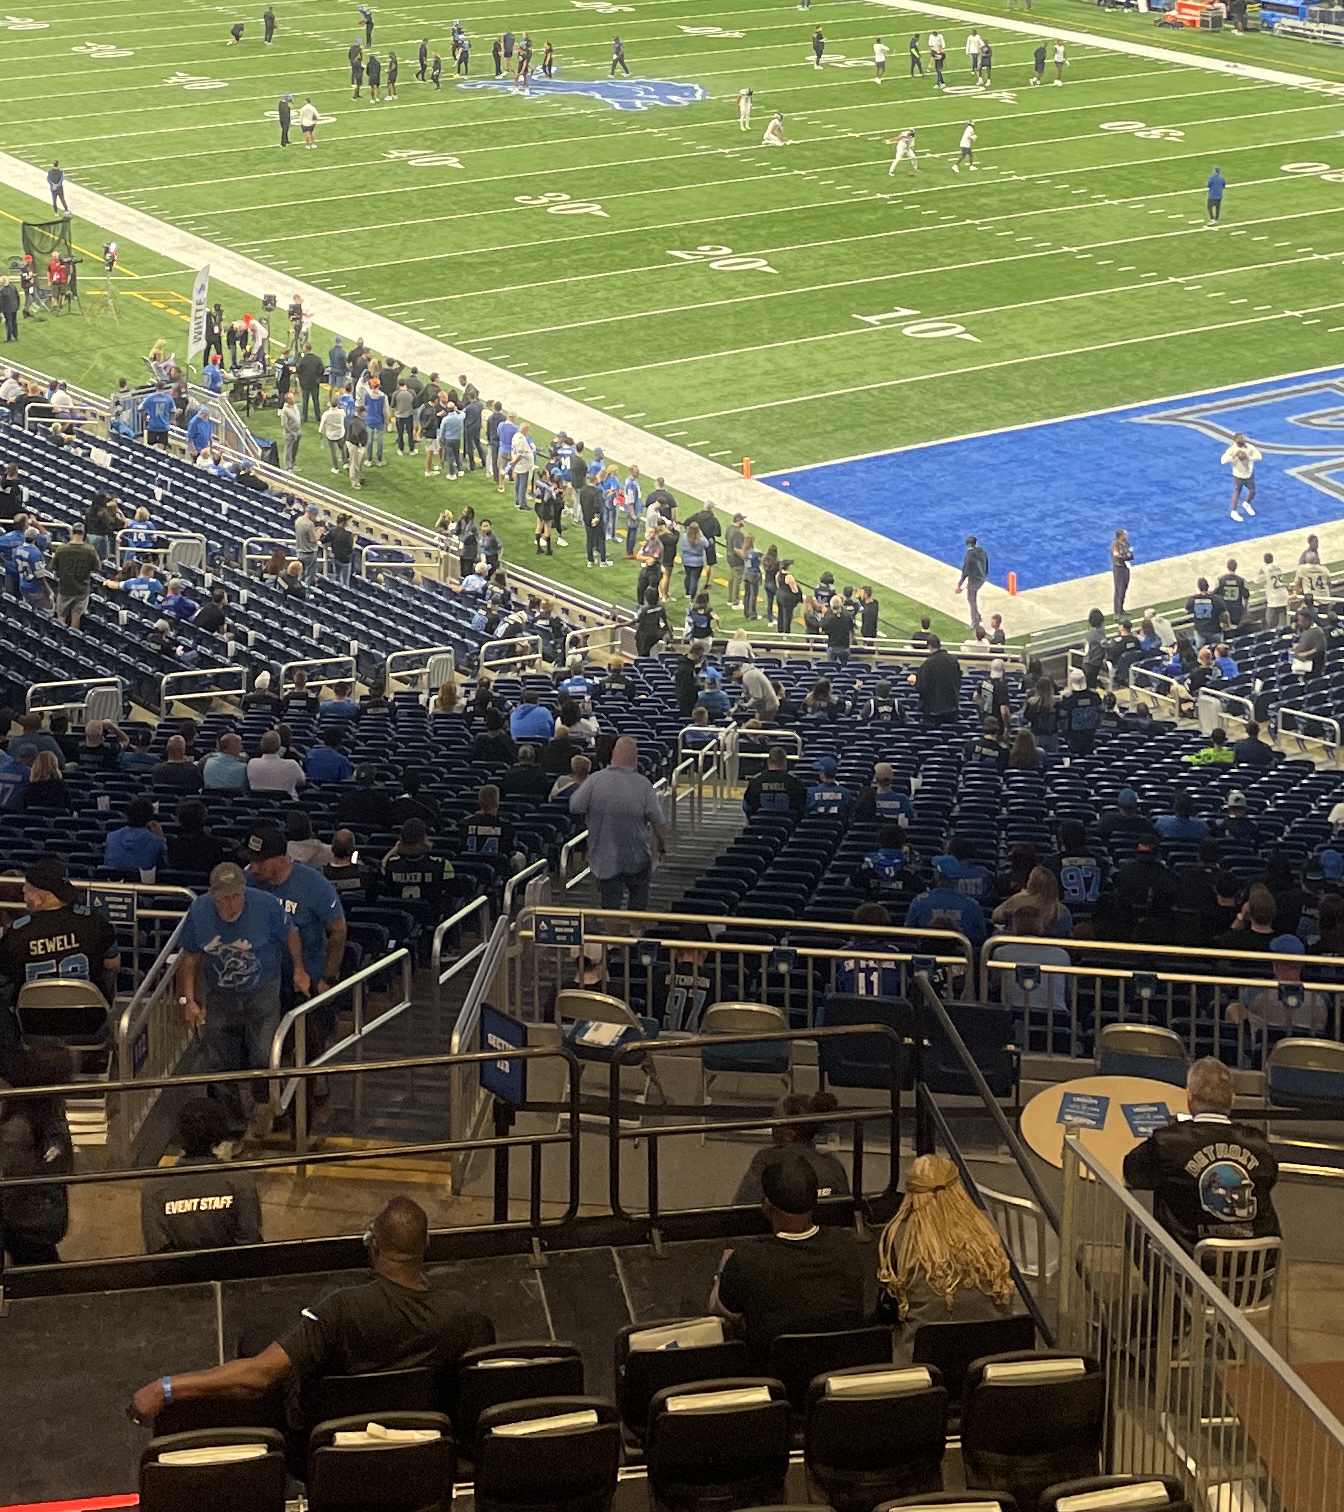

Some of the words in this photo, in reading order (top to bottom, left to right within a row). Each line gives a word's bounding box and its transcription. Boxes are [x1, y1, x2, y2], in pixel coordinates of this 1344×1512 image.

[513, 192, 604, 215] 30
[665, 245, 769, 272] 20
[851, 306, 968, 340] 10
[1060, 865, 1102, 902] 97
[29, 933, 80, 956] SEWELL
[1185, 1142, 1260, 1178] DETROIT
[165, 1198, 200, 1216] EVENT
[200, 1195, 234, 1212] STAFF
